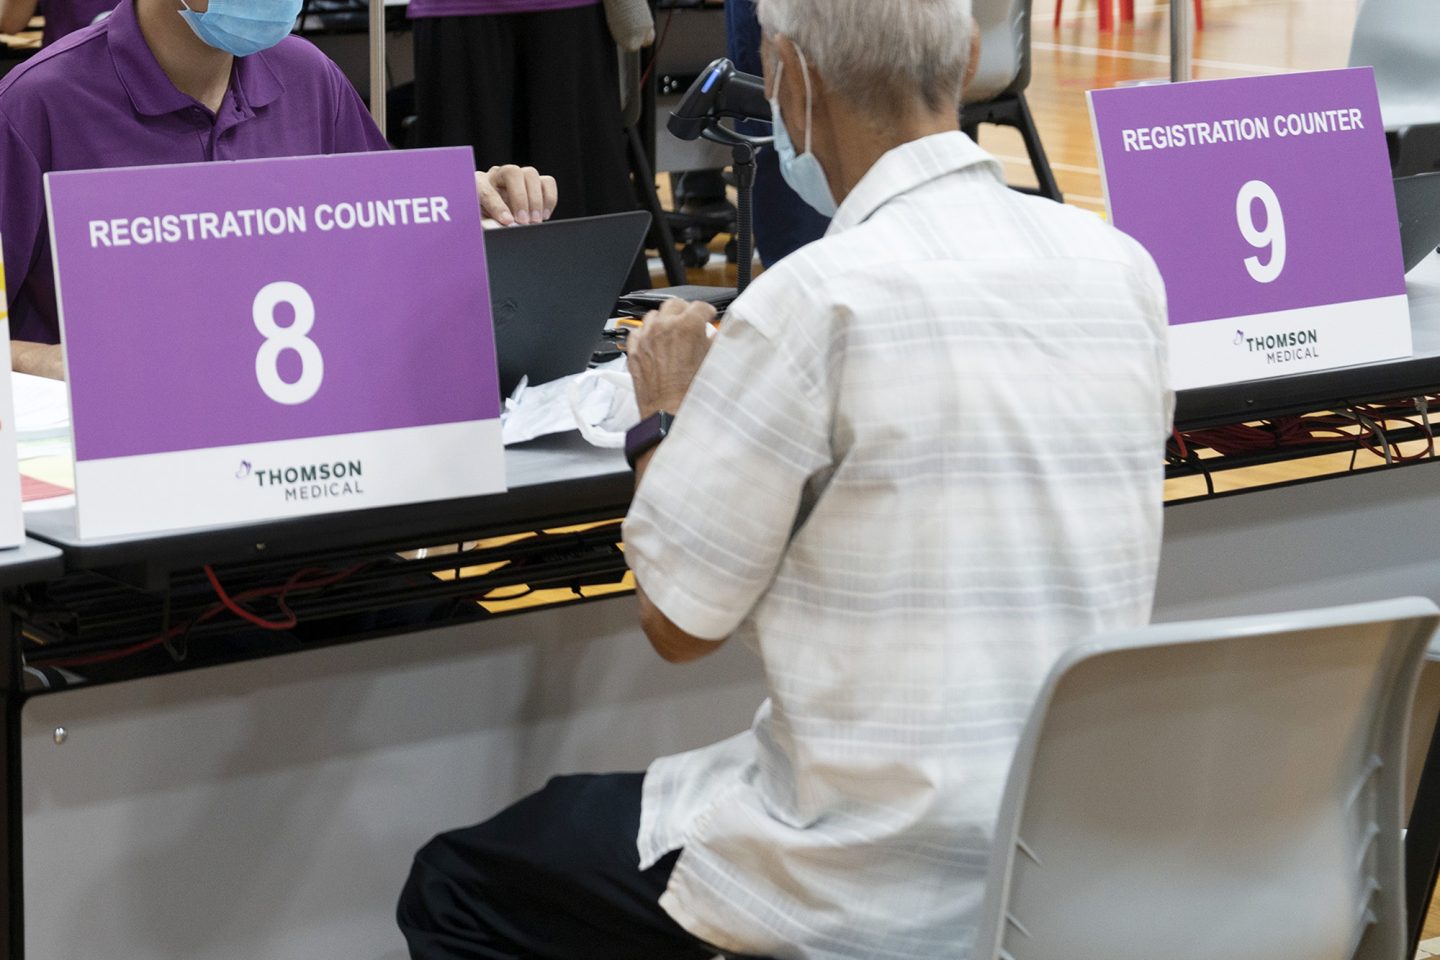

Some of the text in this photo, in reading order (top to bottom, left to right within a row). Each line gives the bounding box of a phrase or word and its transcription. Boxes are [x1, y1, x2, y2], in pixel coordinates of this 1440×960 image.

[1121, 107, 1365, 153] REGISTRATION COUNTER
[88, 195, 452, 249] REGISTRATION COUNTER
[1235, 179, 1288, 284] 9
[252, 280, 325, 406] 8
[1246, 328, 1318, 353] THOMSON
[1266, 346, 1319, 365] MEDICAL
[254, 459, 364, 488] THOMSON
[284, 481, 364, 502] MEDICAL
